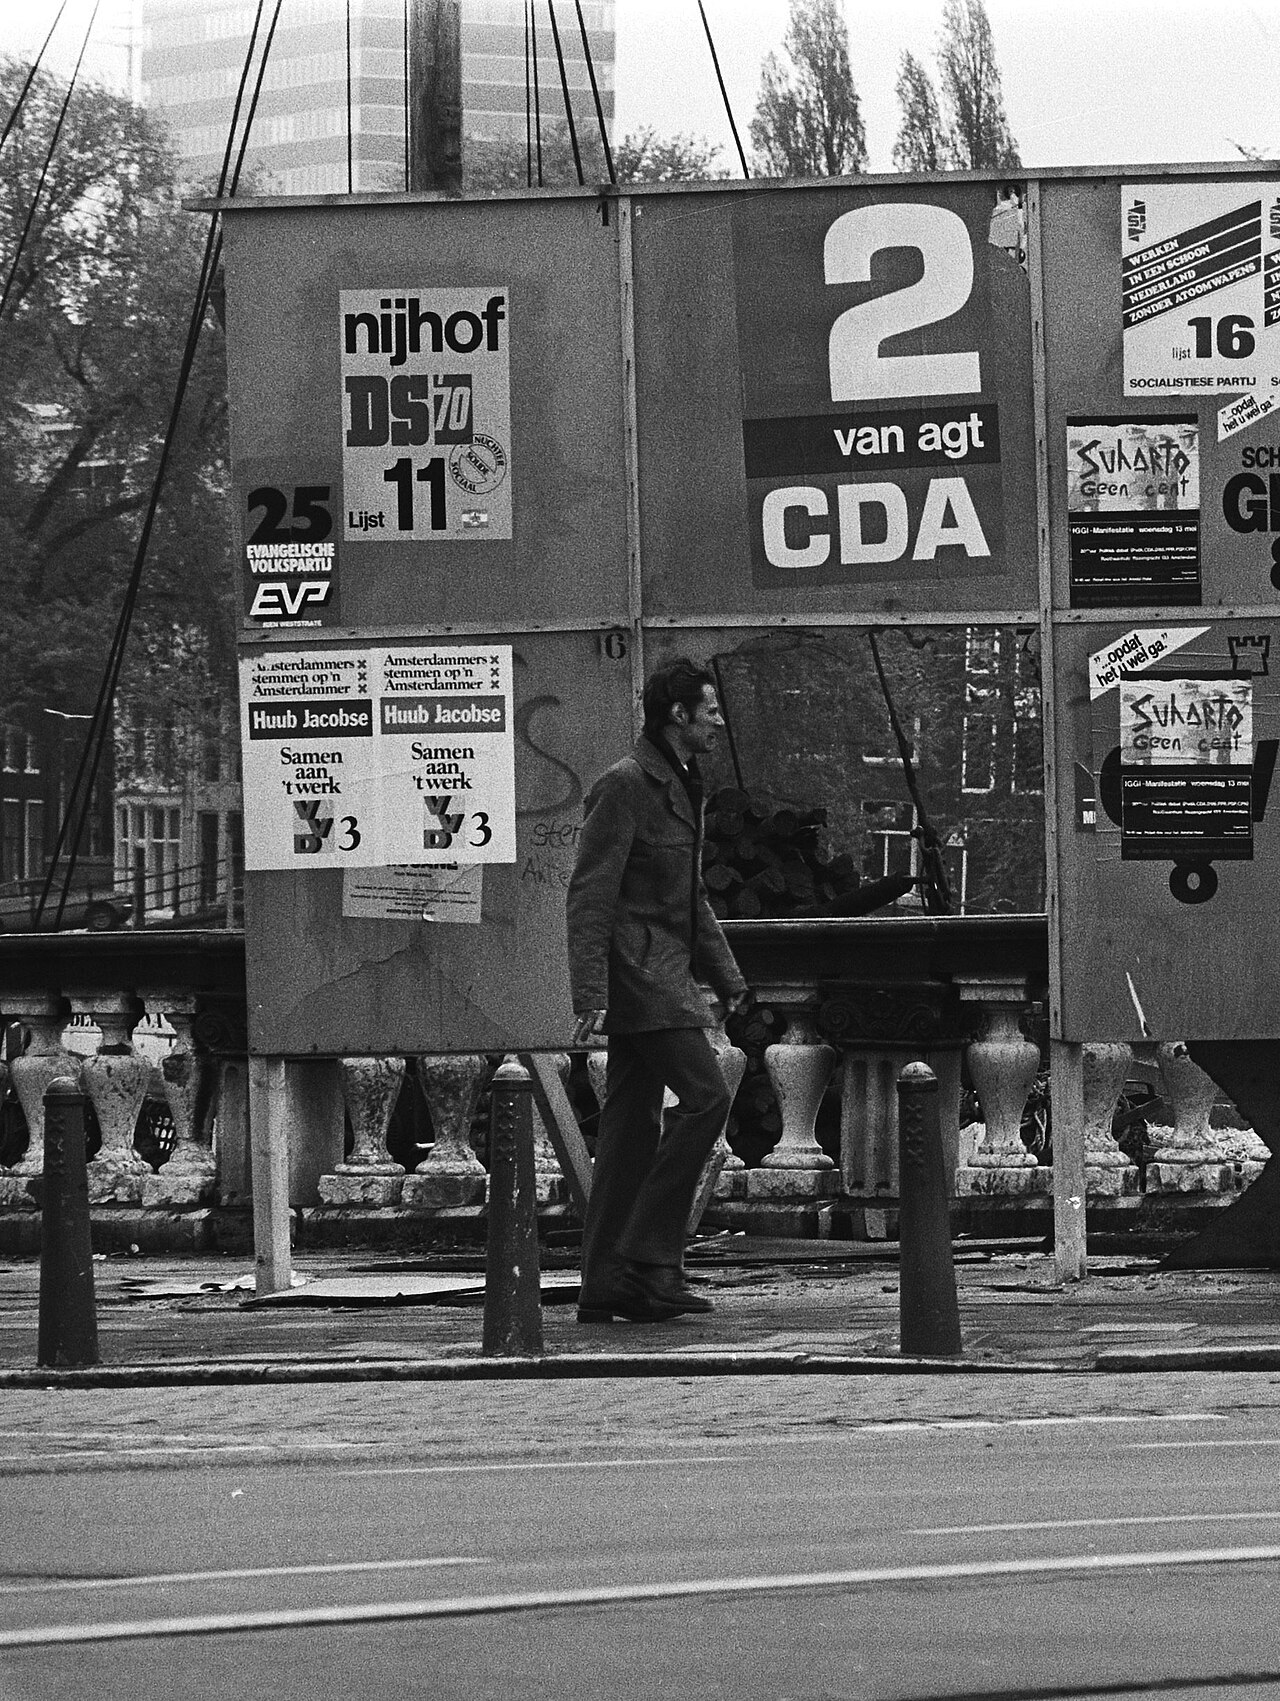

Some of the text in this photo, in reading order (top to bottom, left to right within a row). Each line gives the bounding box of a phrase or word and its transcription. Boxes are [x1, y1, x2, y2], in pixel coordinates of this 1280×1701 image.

[1129, 239, 1179, 266] WERKEN
[1129, 244, 1211, 285] IN EEN SCHOON
[1129, 269, 1196, 303] NEDERLAND
[1129, 262, 1256, 322] ZONDER ATOOMWAPENS
[823, 203, 981, 402] 2
[345, 296, 505, 366] nijhof
[1172, 314, 1256, 361] lijst 16
[1130, 376, 1256, 388] SOCIALISTIESE PARTIJ
[833, 413, 985, 459] van agt
[349, 458, 447, 530] Lijst 11
[1080, 475, 1190, 497] Geen cent
[247, 486, 333, 543] 25
[762, 477, 991, 569] CDA
[246, 543, 335, 559] EVANGELISCHE
[250, 557, 332, 573] VOLKSPARTIJ
[249, 581, 331, 616] EVP
[605, 633, 627, 659] 6
[384, 653, 487, 666] Amsterdammers
[252, 673, 308, 684] stemmen
[312, 674, 328, 685] op
[384, 669, 441, 679] stemmen
[444, 669, 460, 680] op
[384, 678, 483, 691] Amsterdammer
[1096, 666, 1119, 687] het
[253, 683, 351, 697] Amsterdammer
[253, 708, 368, 729] Huub Jacobse
[384, 703, 501, 724] Huub Jacobse
[411, 742, 475, 760] Samen
[1133, 734, 1181, 750] Geen
[280, 746, 343, 765] Samen
[295, 766, 329, 779] aan
[426, 762, 459, 774] aan
[295, 776, 341, 794] werk
[426, 772, 473, 790] werk
[293, 800, 334, 854] VVD
[423, 795, 466, 849] VVD
[469, 812, 492, 847] 3
[338, 815, 361, 851] 3
